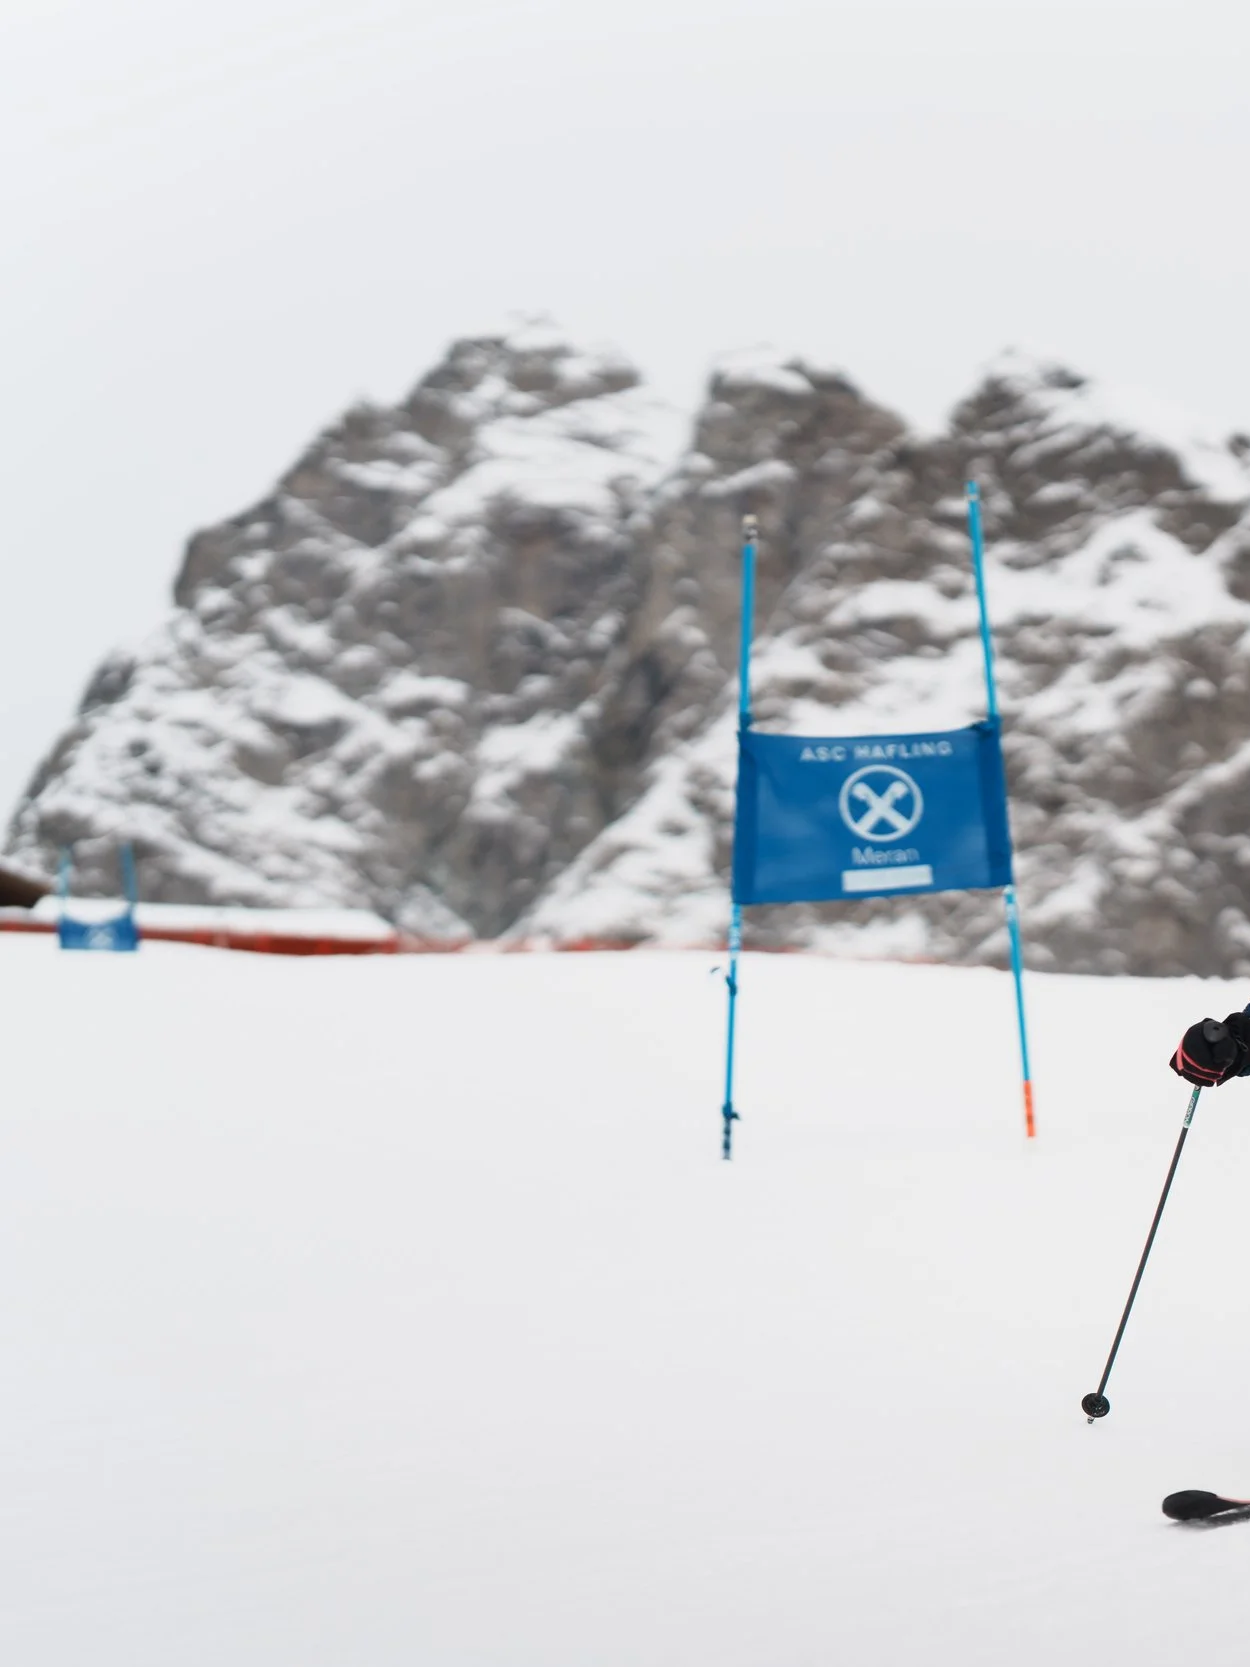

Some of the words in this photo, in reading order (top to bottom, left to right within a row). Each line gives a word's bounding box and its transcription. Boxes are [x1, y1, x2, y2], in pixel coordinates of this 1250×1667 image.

[800, 746, 846, 762] ASC
[854, 741, 953, 760] HAFLING
[851, 846, 920, 865] Meran
